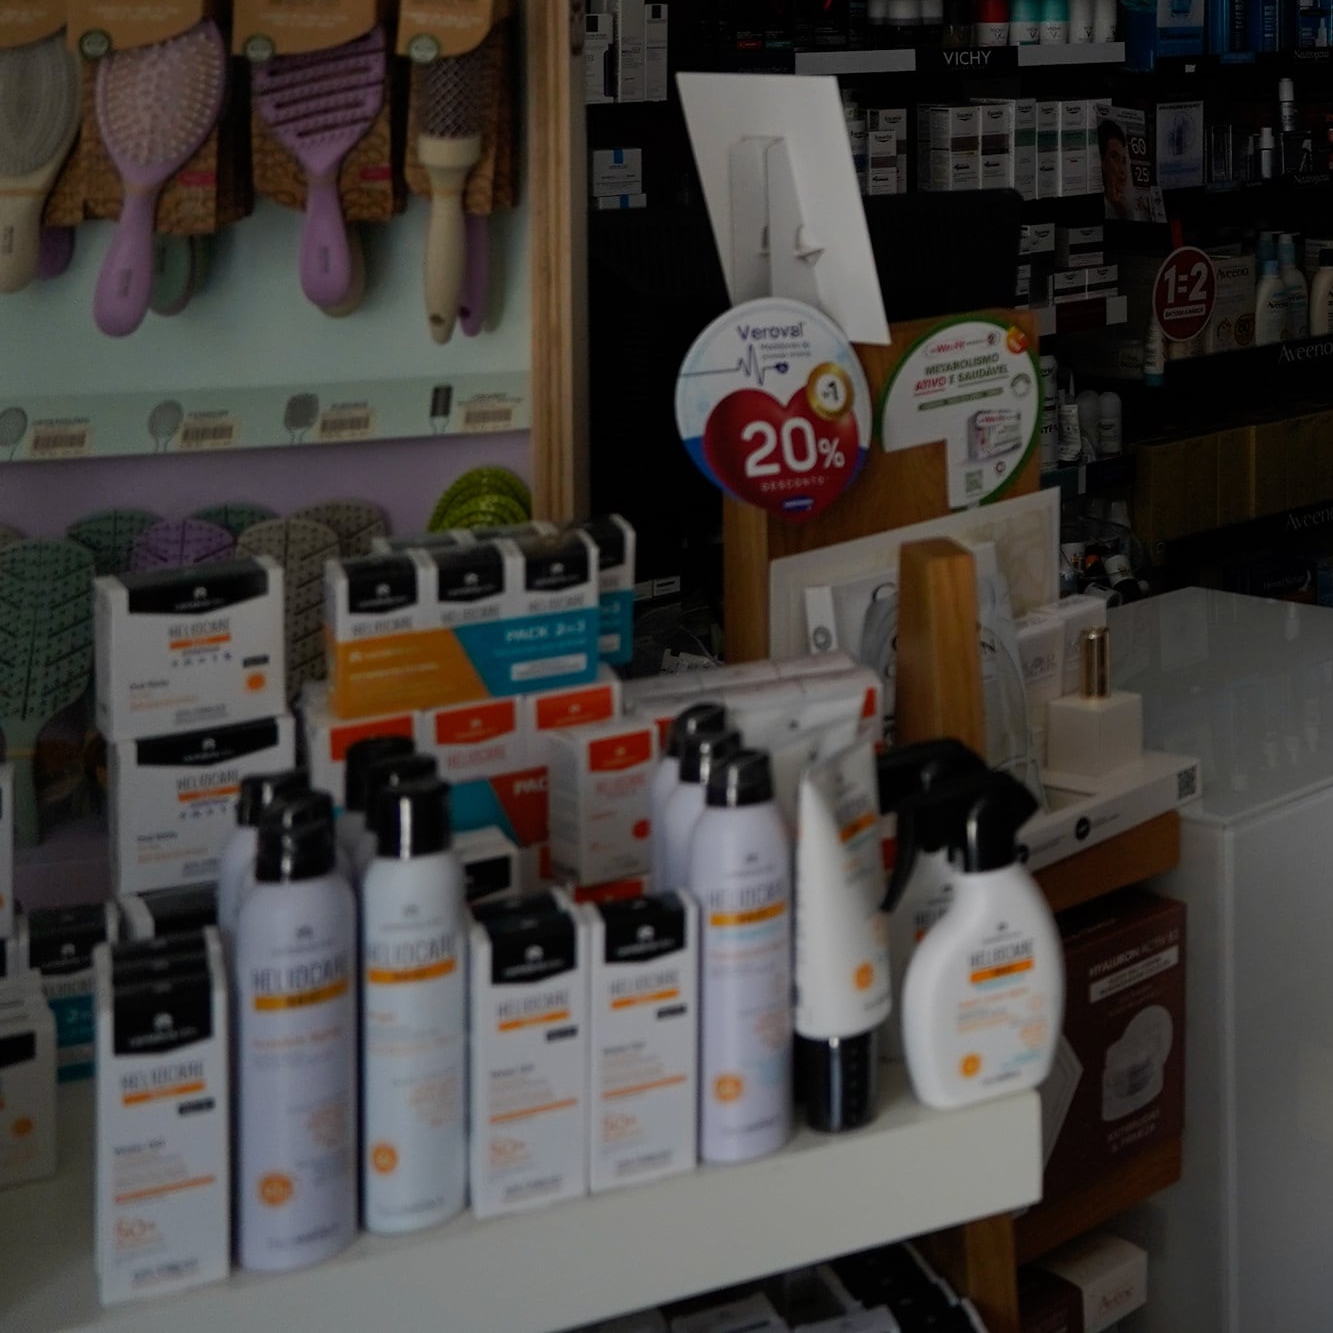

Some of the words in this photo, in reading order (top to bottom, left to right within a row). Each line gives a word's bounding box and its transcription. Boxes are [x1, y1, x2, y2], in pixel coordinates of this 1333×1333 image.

[736, 321, 804, 342] Veroval
[925, 353, 1000, 376] METABOLISMO
[740, 417, 846, 480] 20%
[759, 477, 825, 492] DESCONTO
